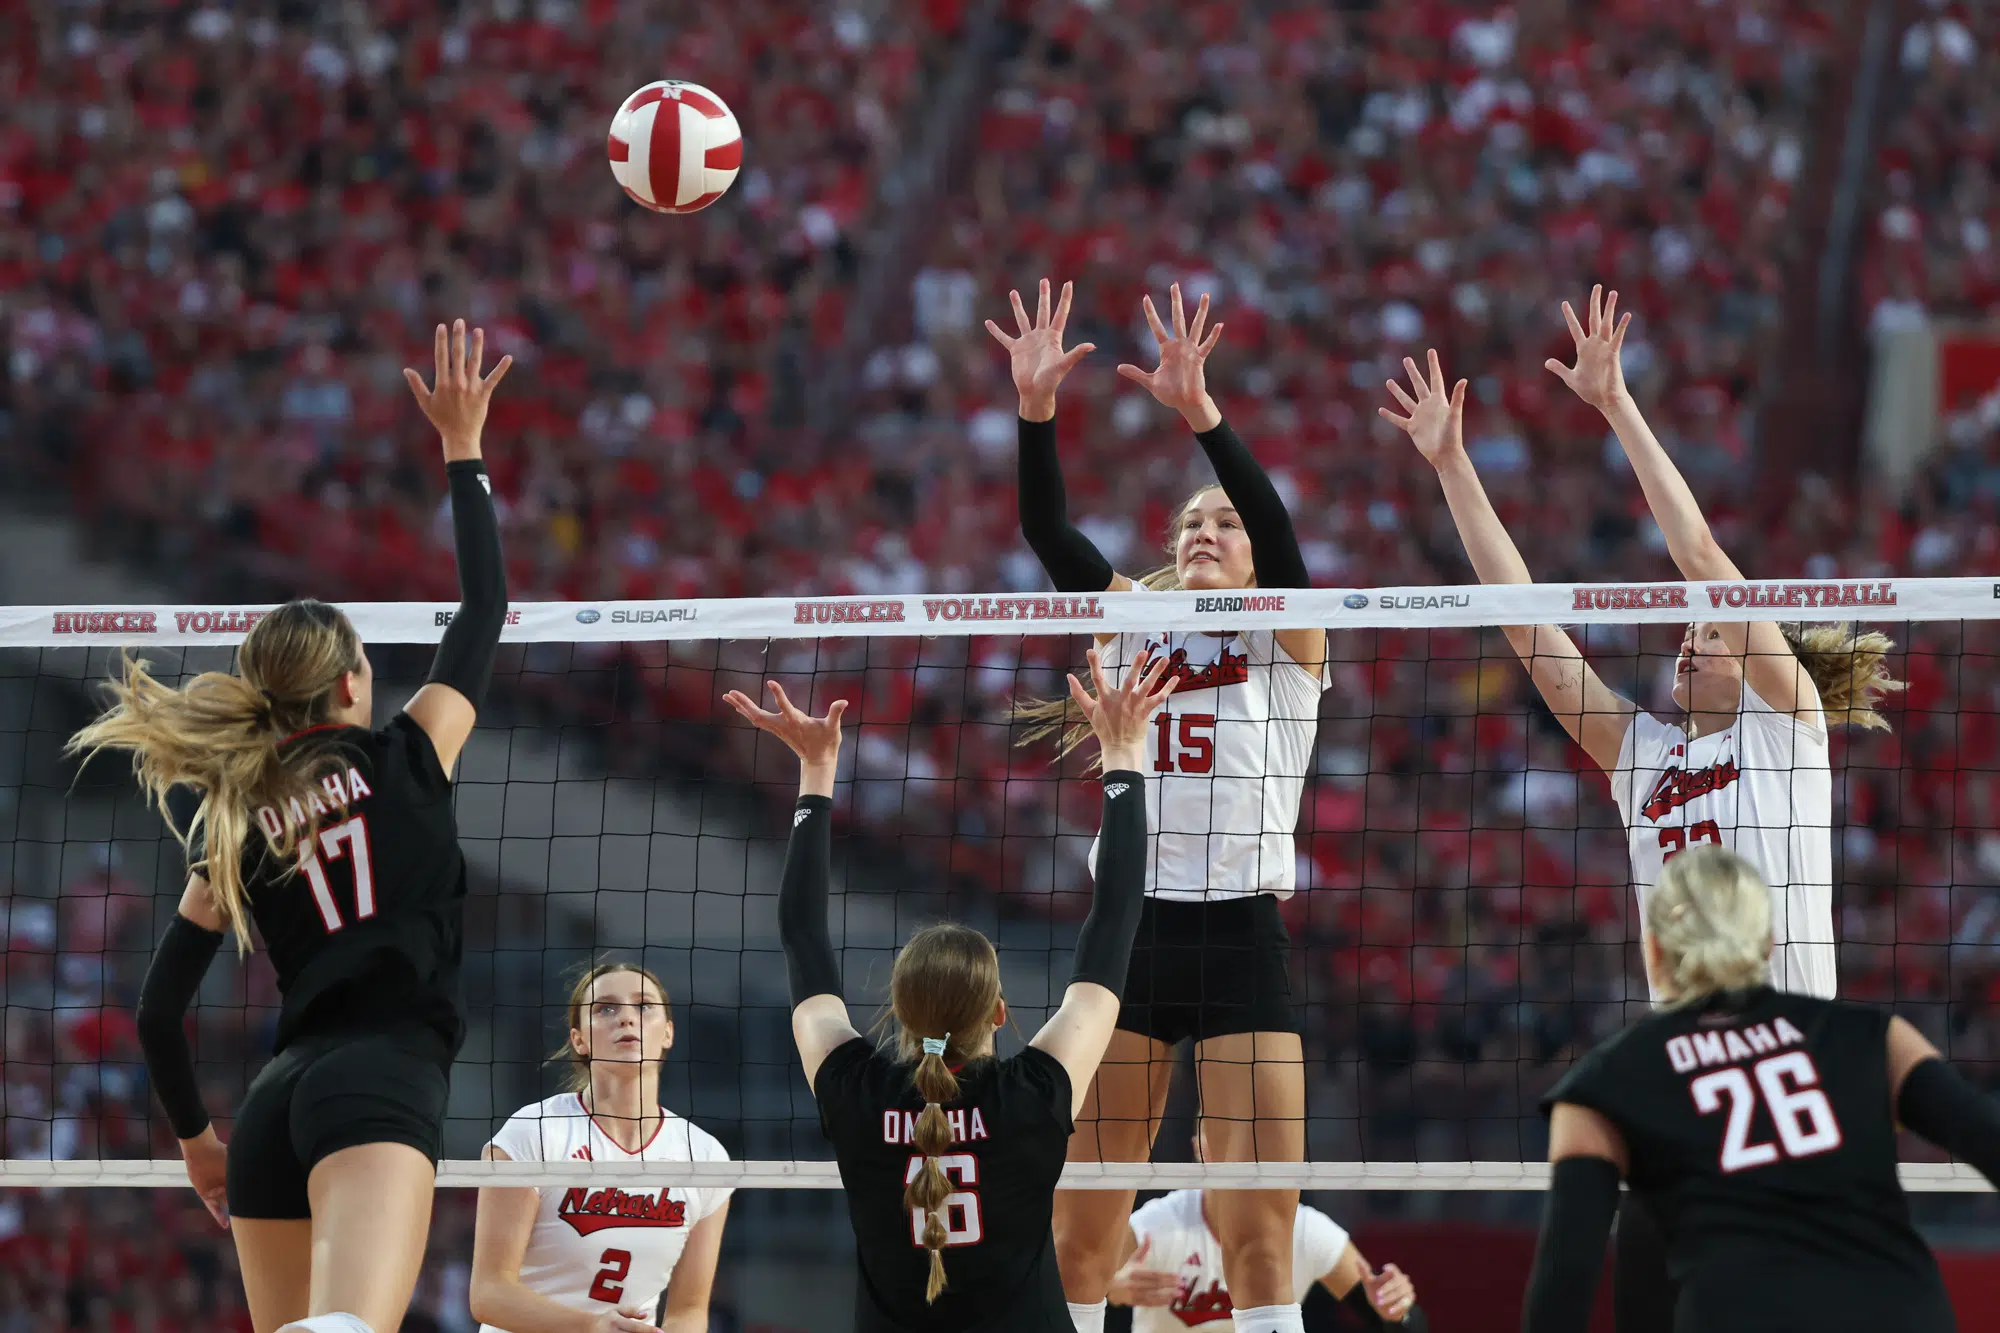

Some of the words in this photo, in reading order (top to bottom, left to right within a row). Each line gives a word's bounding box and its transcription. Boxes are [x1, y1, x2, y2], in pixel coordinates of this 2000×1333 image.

[794, 601, 905, 624] HUSKER
[923, 597, 1105, 621] VOLLEYBALL
[1195, 595, 1285, 612] BEARDMORE
[1379, 594, 1471, 610] SUBARU
[1572, 586, 1688, 610] HUSKER
[1706, 583, 1897, 608] VOLLEYBALL
[52, 611, 157, 634] HUSKER
[611, 608, 698, 624] SUBARU
[1153, 711, 1216, 773] 15
[297, 812, 377, 935] 17
[1664, 1016, 1805, 1075] OMAHA
[882, 1107, 990, 1144] OMHA
[1690, 1050, 1843, 1175] 26
[588, 1247, 631, 1304] 2
